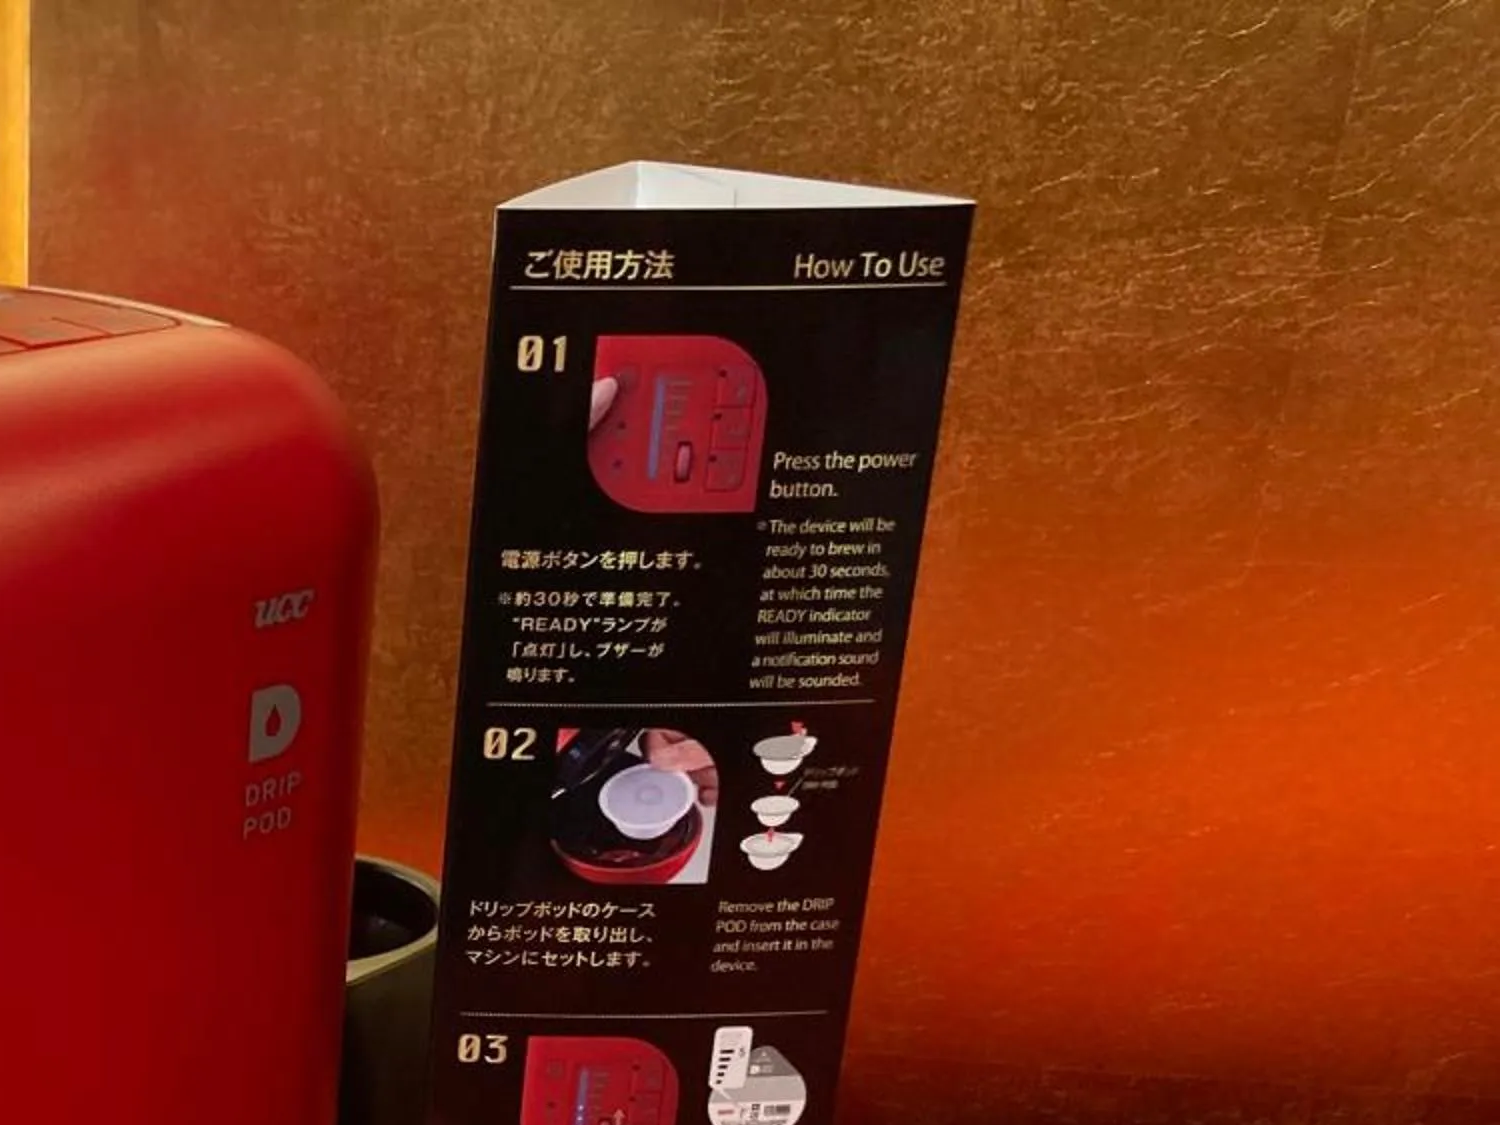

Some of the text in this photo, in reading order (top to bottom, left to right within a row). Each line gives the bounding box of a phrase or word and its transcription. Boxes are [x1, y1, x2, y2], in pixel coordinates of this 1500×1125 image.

[523, 250, 675, 280] ご使用方法
[793, 251, 946, 280] How To Use
[517, 335, 568, 373] 01
[773, 450, 917, 473] Press the power
[769, 479, 839, 498] button.
[769, 519, 797, 534] The
[799, 518, 847, 534] device
[849, 517, 875, 532] will
[876, 517, 897, 532] be
[501, 549, 702, 570] 電源ボタンを押します。
[765, 541, 882, 560] ready to brew in
[763, 564, 806, 579] about
[809, 564, 828, 578] 30
[760, 584, 884, 601] at which time the
[757, 607, 872, 623] READY indicator
[855, 628, 883, 643] and
[838, 649, 879, 665] sound
[484, 727, 537, 761] 02
[245, 771, 301, 807] DRIP
[243, 806, 291, 840] POD
[468, 902, 656, 919] ドリップポッドのケース
[467, 948, 652, 968] マシンにセットします。
[457, 1034, 510, 1065] 03
